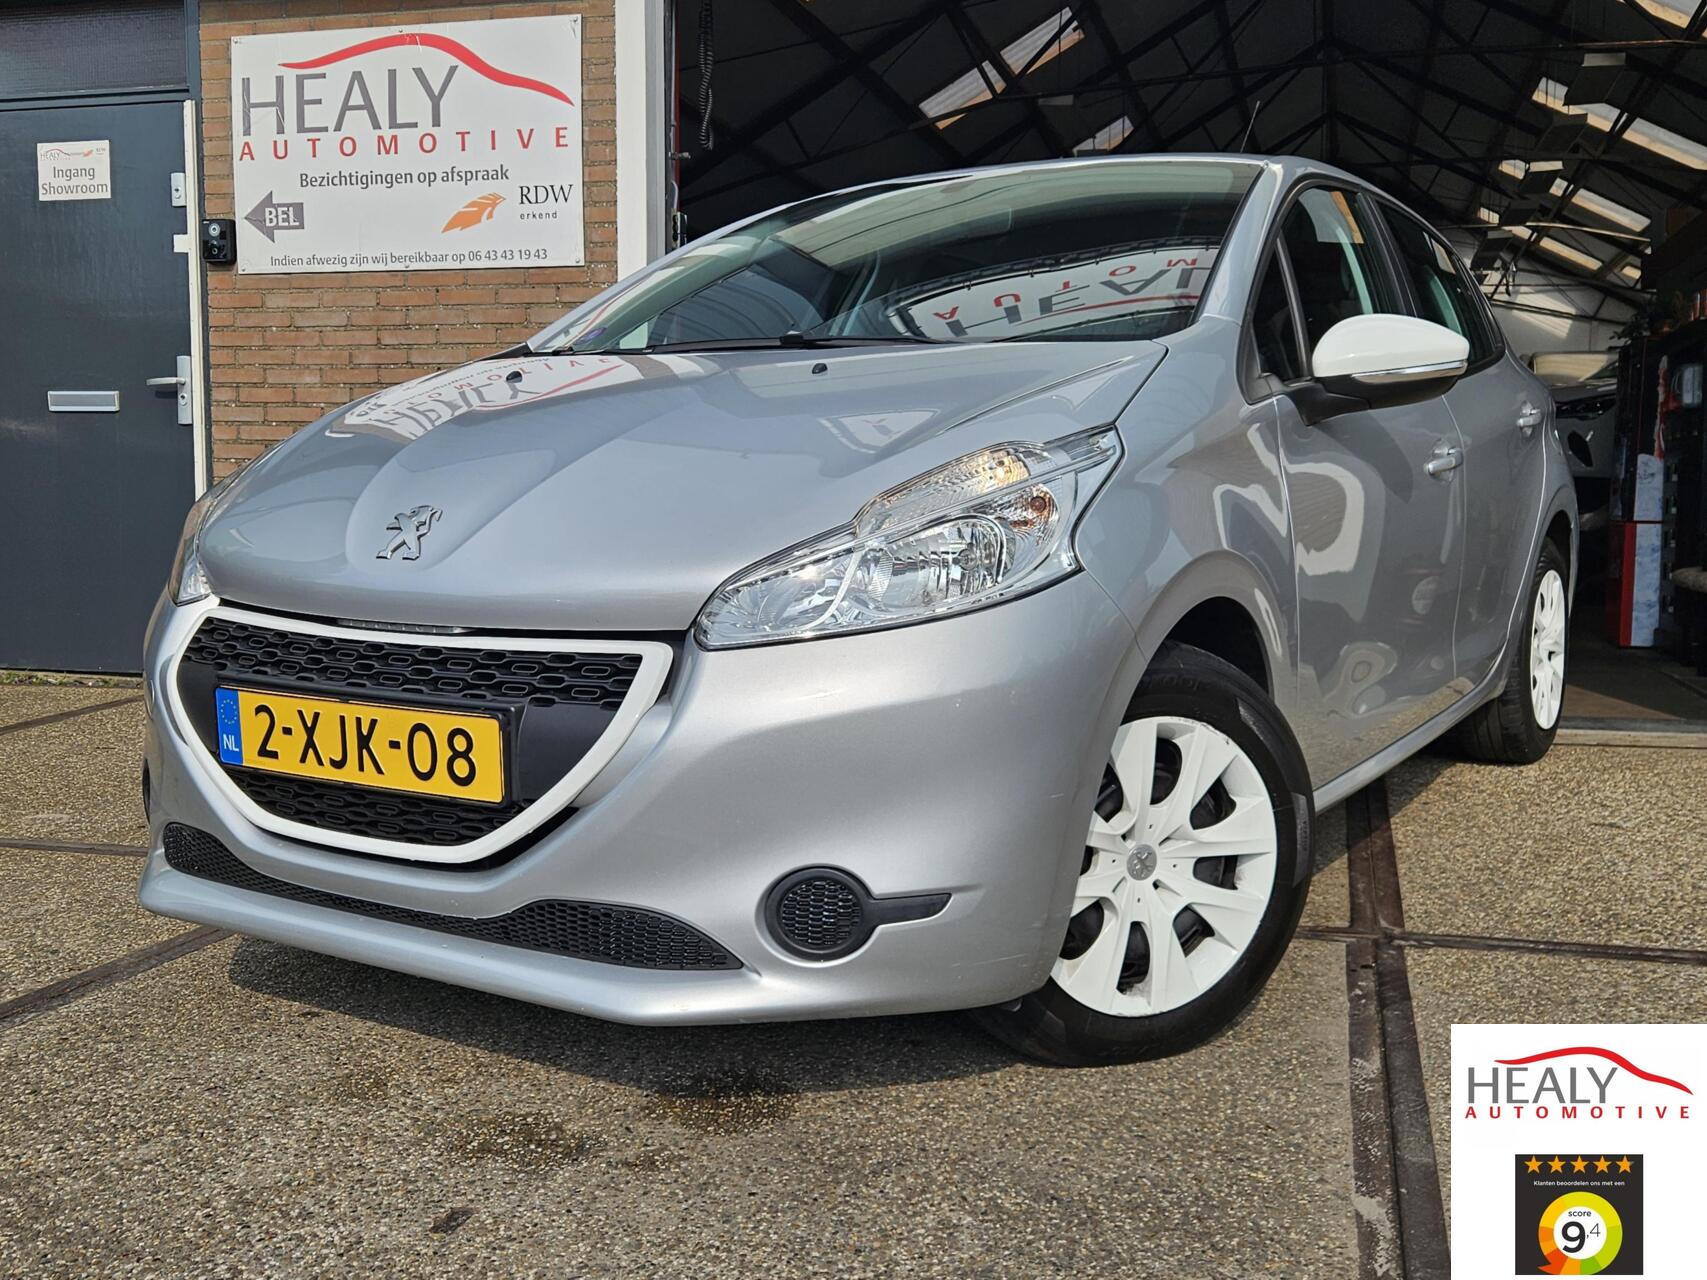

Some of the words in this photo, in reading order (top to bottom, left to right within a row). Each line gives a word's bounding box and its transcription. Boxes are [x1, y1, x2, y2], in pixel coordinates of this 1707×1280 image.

[241, 65, 459, 136] HEALY
[239, 127, 569, 161] AUTOMOTIVE
[53, 166, 95, 181] Ingang
[300, 171, 413, 190] Bezichtigingen
[417, 171, 437, 187] op
[441, 164, 510, 186] afspraak
[41, 182, 108, 195] Showroom
[519, 184, 574, 205] RDW
[265, 206, 299, 227] BEL
[520, 211, 557, 220] erkend
[271, 255, 303, 266] Indien
[306, 254, 348, 267] afwezig
[350, 253, 369, 267] zijn
[370, 253, 388, 266] wij
[390, 251, 449, 264] bereikbaar
[452, 252, 465, 264] op
[468, 250, 482, 261] 06
[484, 250, 498, 261] 43
[500, 249, 514, 260] 43
[519, 249, 532, 260] 19
[534, 248, 548, 260] 43
[223, 734, 239, 752] NL
[254, 704, 477, 787] 2-XJK-08
